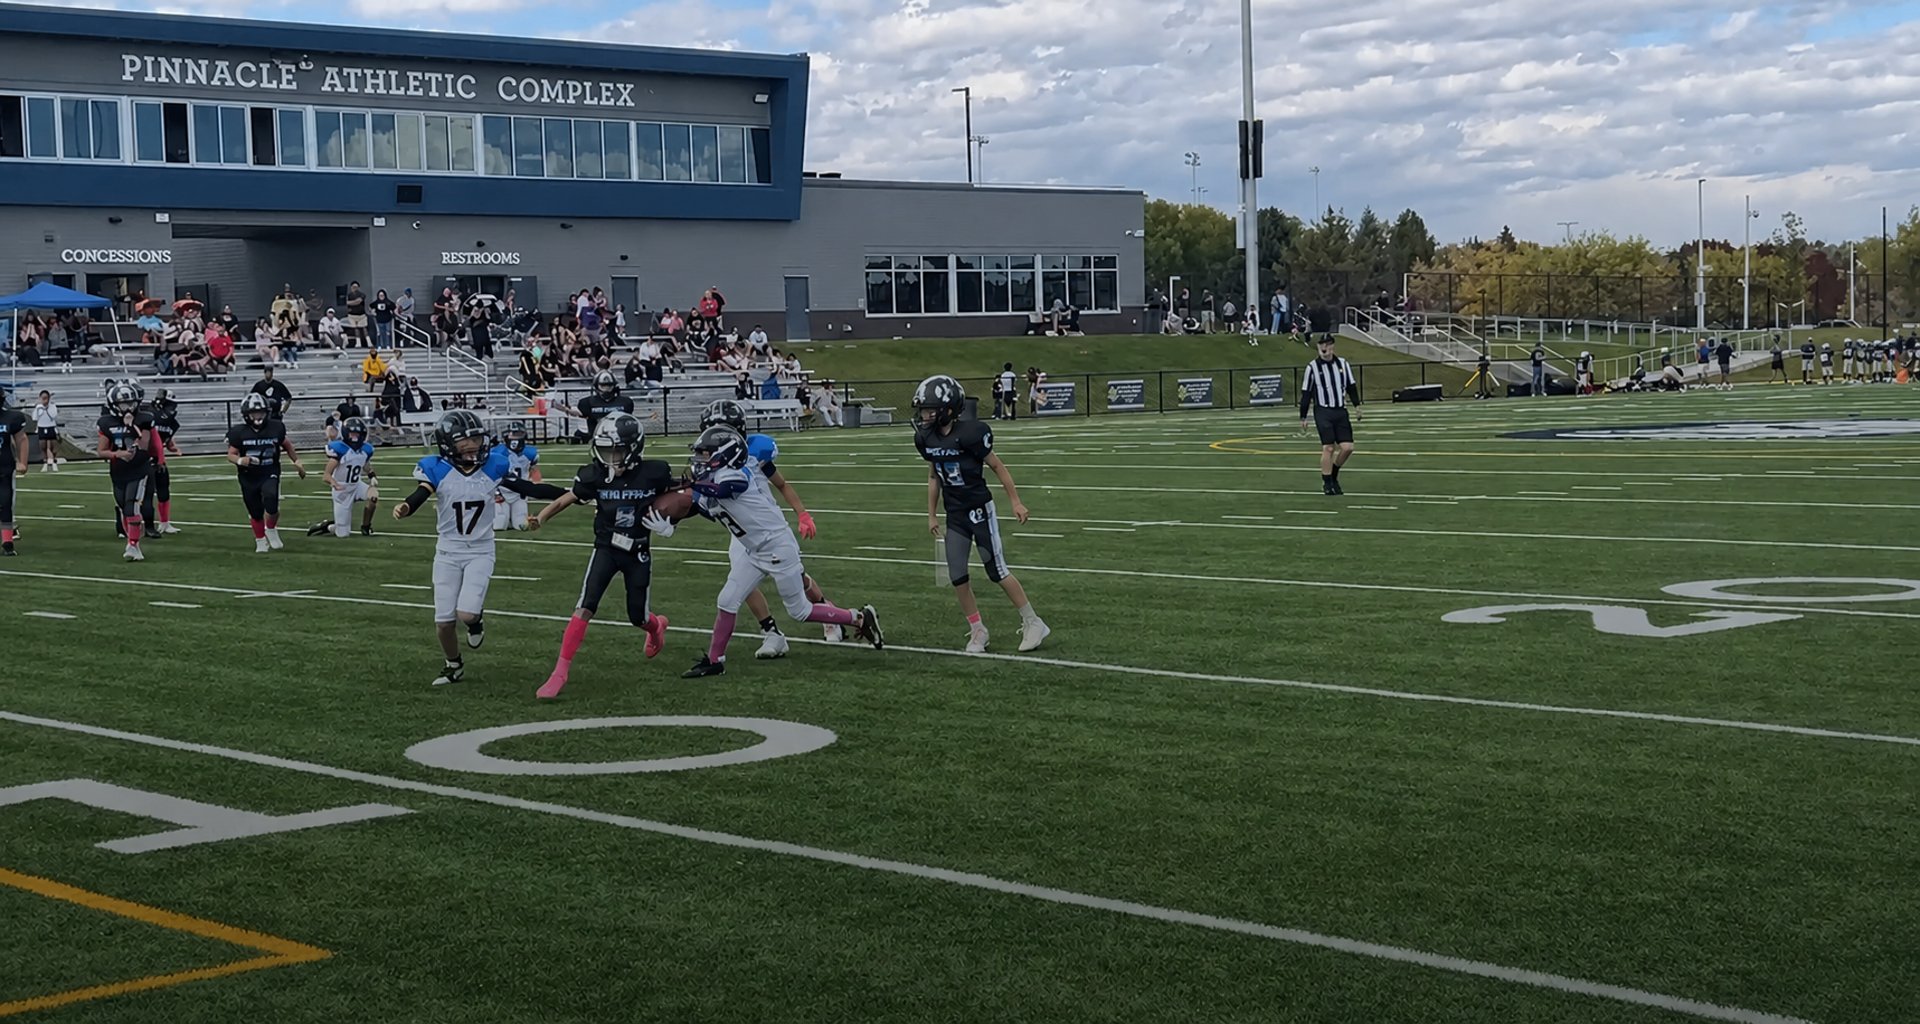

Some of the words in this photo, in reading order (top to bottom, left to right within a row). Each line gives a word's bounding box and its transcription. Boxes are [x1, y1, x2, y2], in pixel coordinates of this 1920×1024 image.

[121, 54, 298, 90] PINNACLE
[321, 66, 477, 99] ATHLETIC
[498, 76, 635, 107] COMPLEX
[61, 248, 172, 263] CONCESSIONS
[441, 251, 521, 265] RESTROOMS
[345, 464, 362, 483] 18
[451, 500, 485, 536] 17
